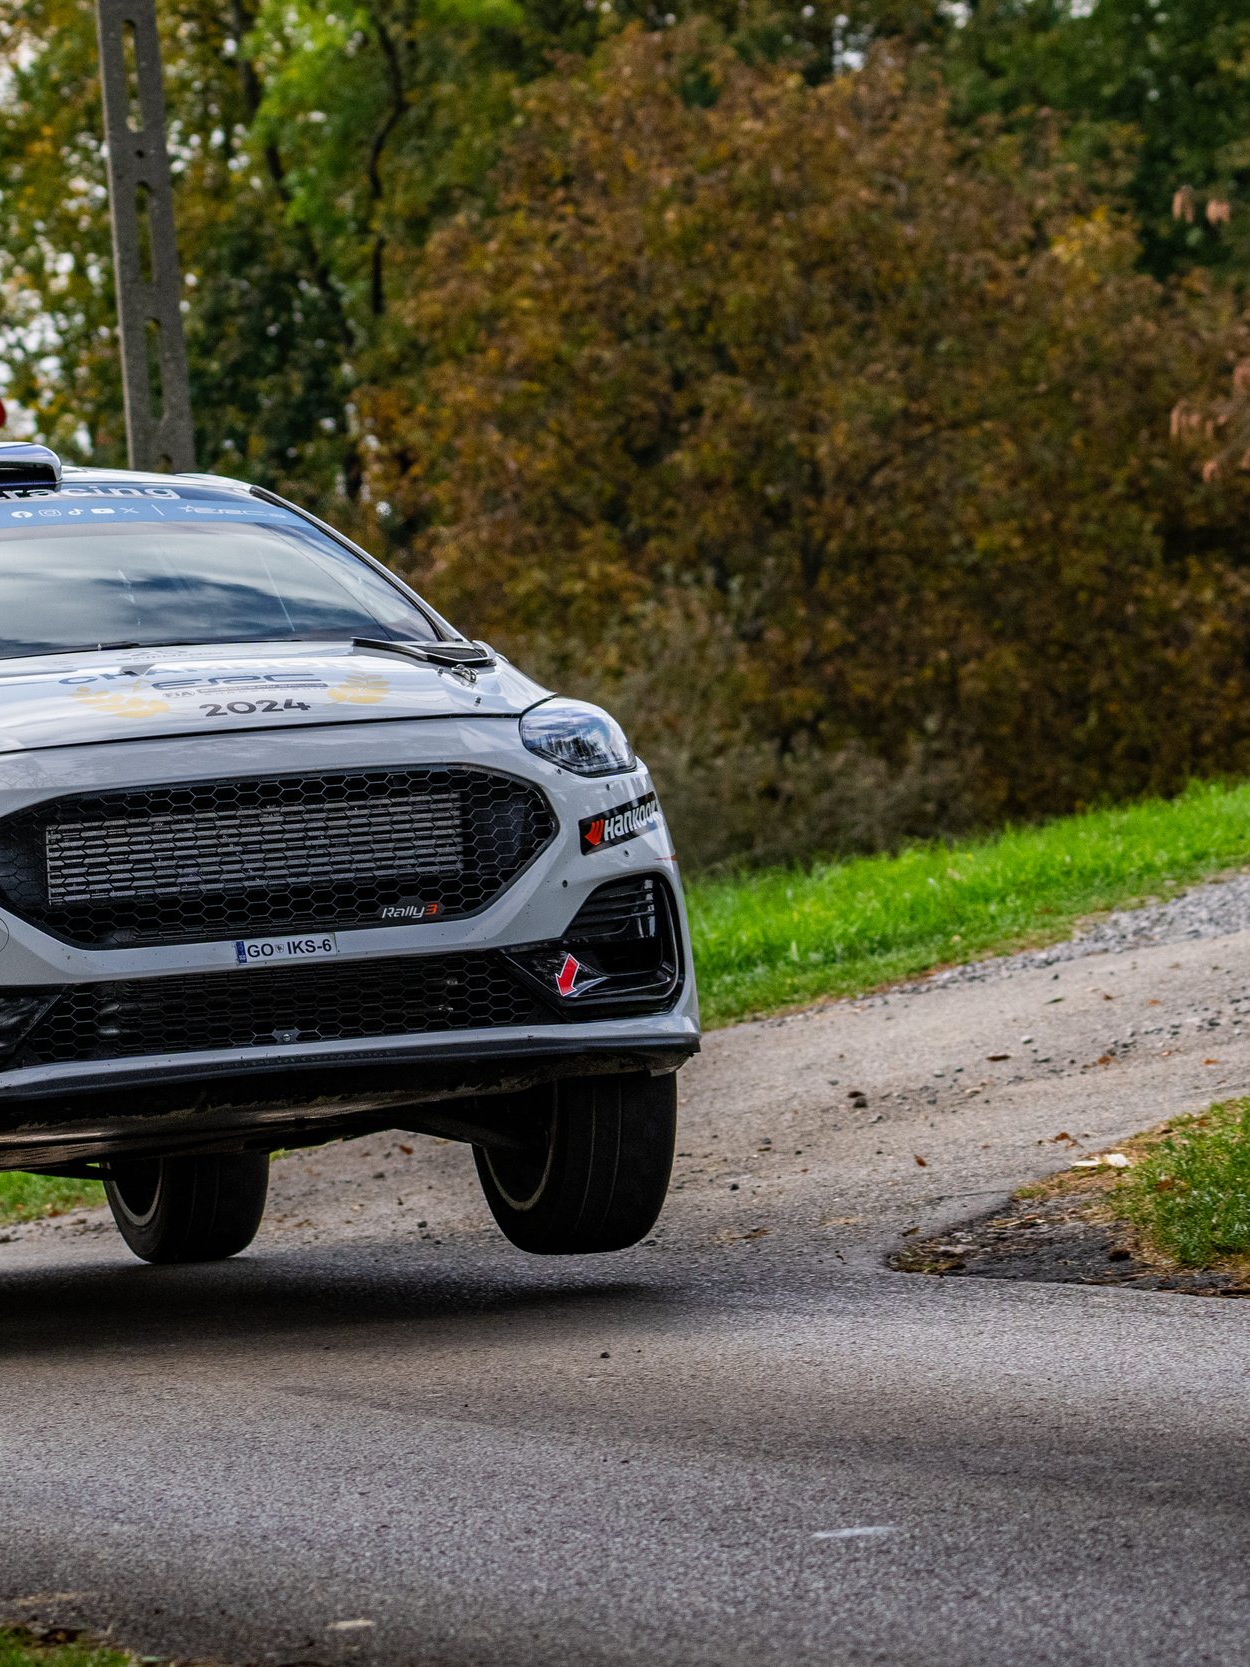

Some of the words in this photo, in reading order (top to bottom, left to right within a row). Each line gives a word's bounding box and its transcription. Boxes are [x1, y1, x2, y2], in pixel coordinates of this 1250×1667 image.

[199, 698, 312, 717] 2024
[382, 903, 438, 919] Rally3
[287, 939, 332, 954] IKS-6
